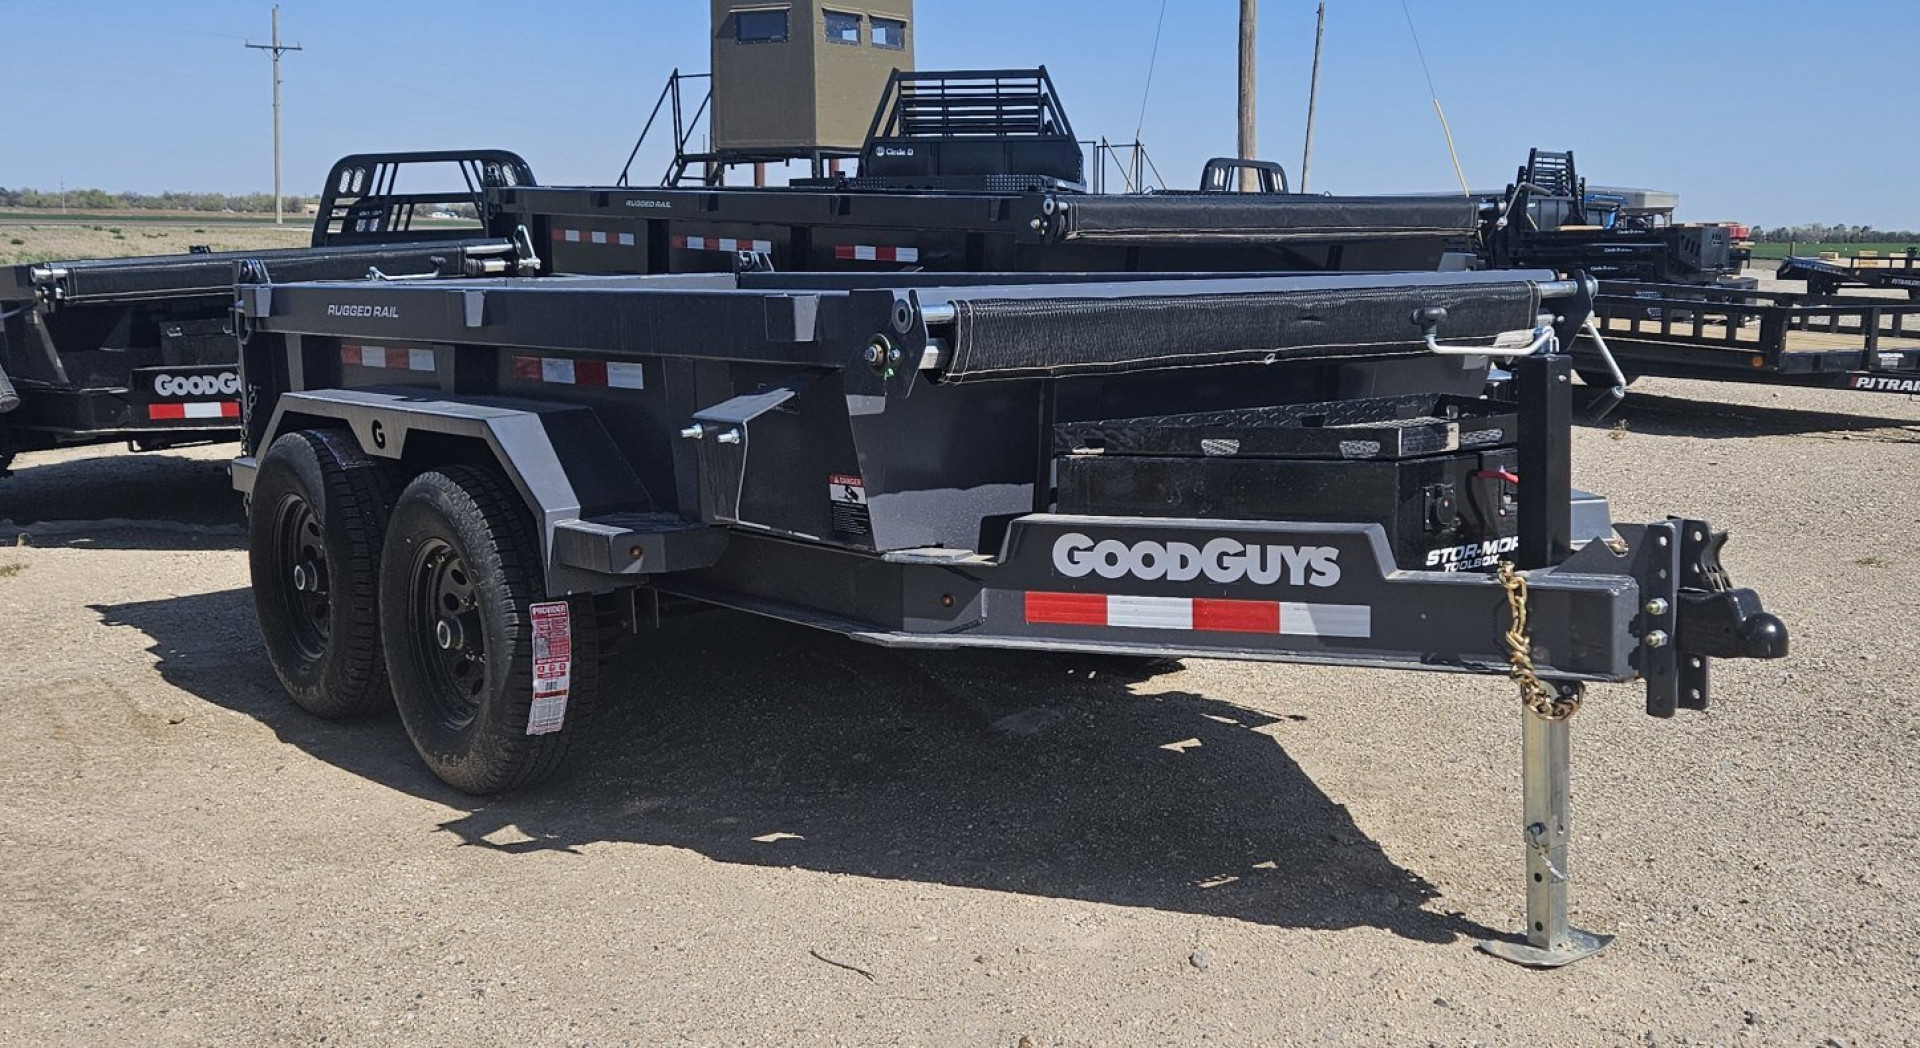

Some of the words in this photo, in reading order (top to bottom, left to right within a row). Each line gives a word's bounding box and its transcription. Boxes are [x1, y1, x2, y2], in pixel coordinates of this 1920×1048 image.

[327, 304, 372, 317] RUGGED
[373, 305, 399, 318] RAIL
[1877, 378, 1920, 391] TRAI
[372, 420, 386, 450] G
[1052, 532, 1341, 588] GOODGUYS
[1444, 554, 1500, 573] TOOLBOX
